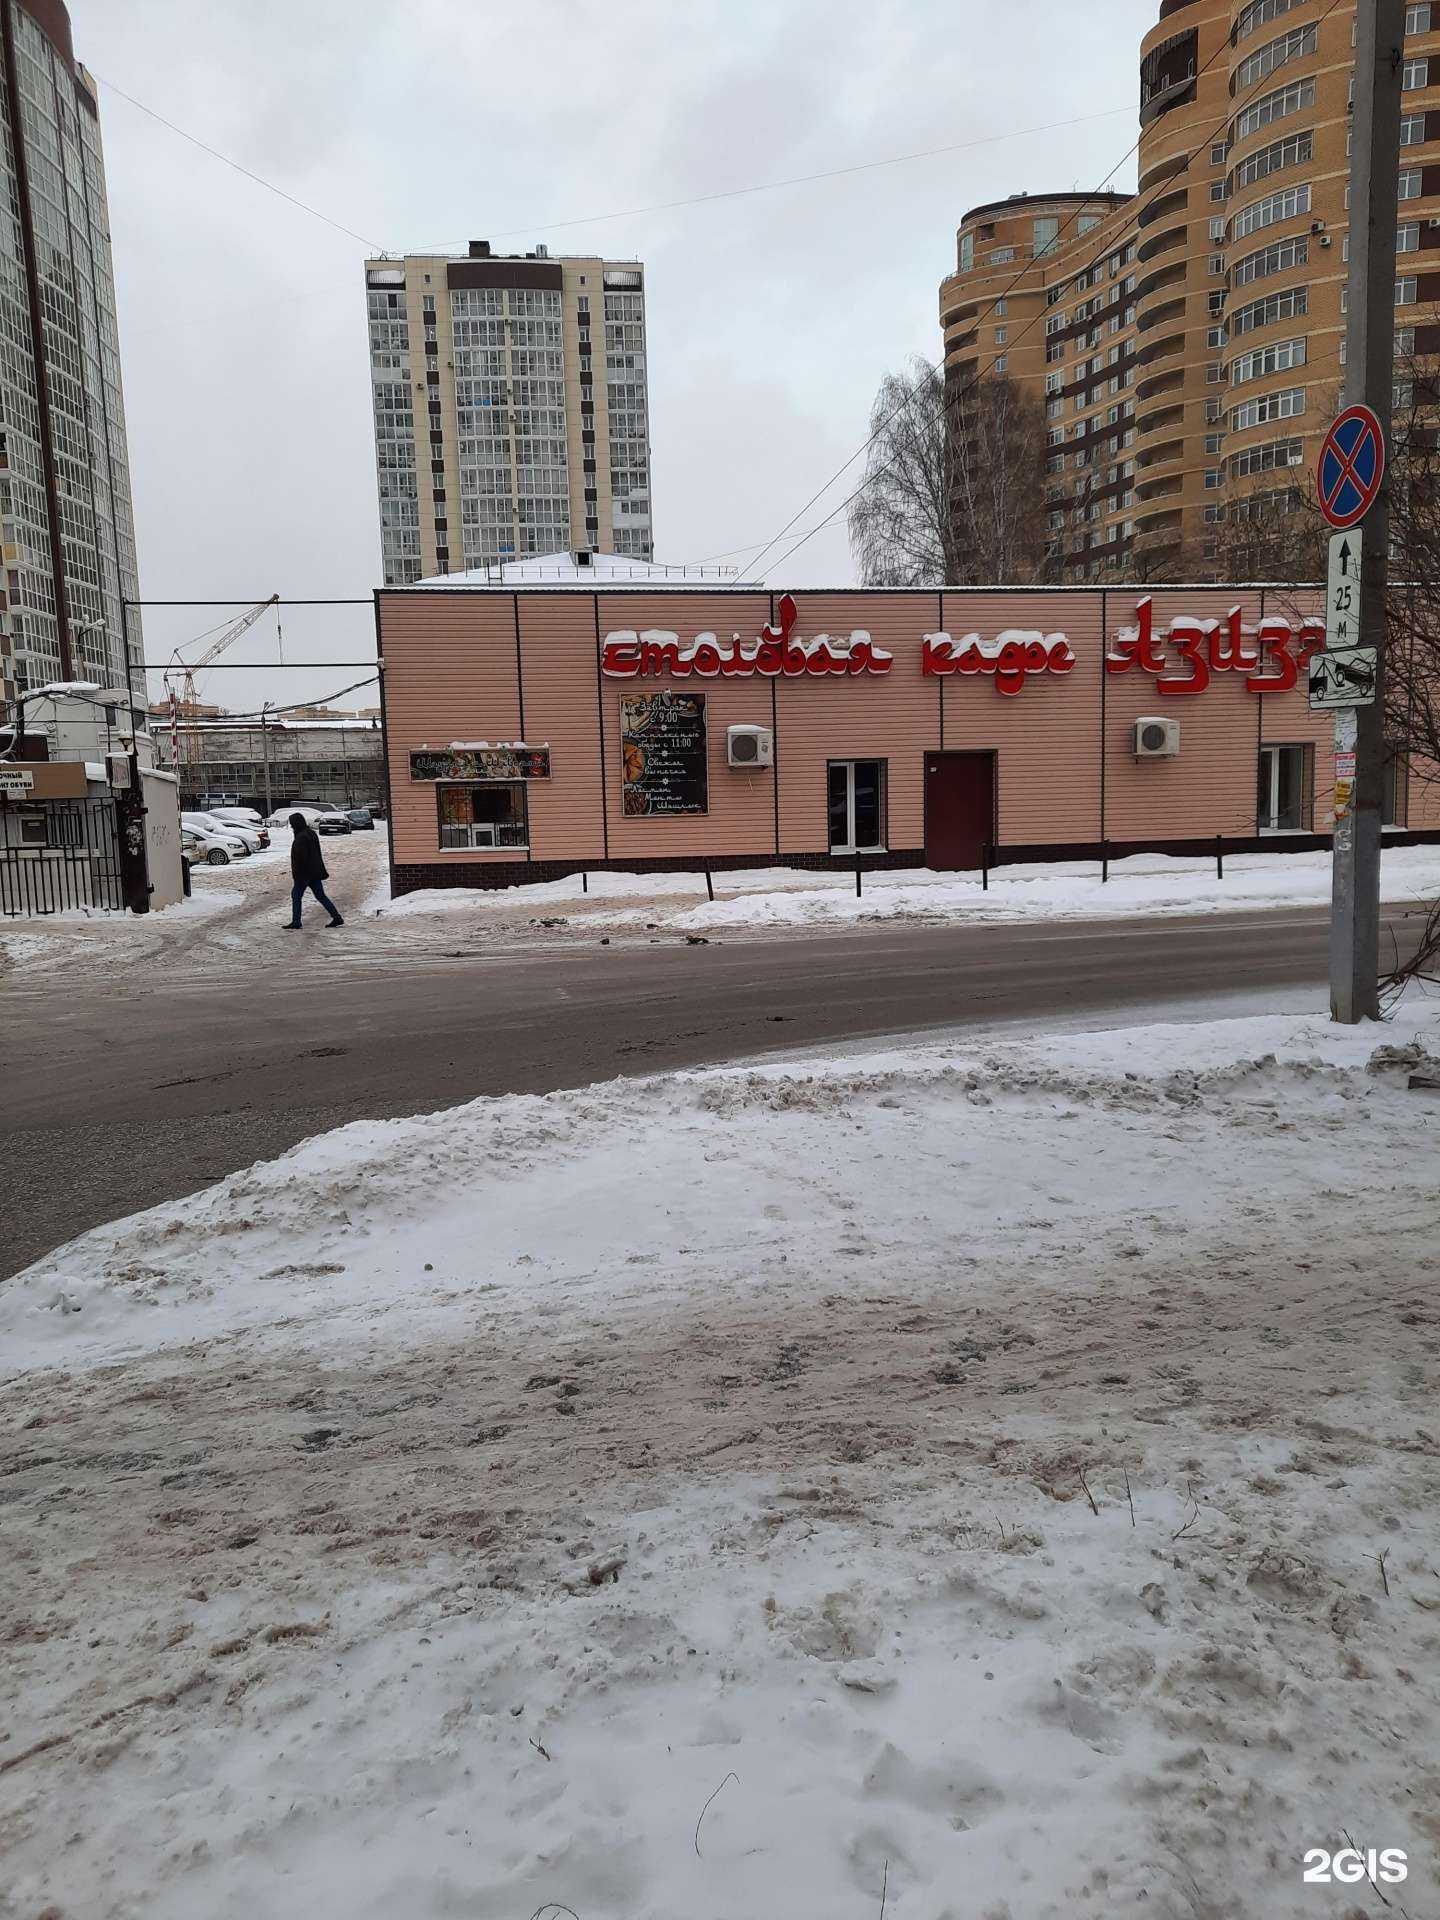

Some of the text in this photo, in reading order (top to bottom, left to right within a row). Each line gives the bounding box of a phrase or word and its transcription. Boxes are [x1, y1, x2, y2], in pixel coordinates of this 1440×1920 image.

[1335, 585, 1352, 611] 25
[658, 711, 678, 723] 9:00
[671, 738, 692, 748] 11:00
